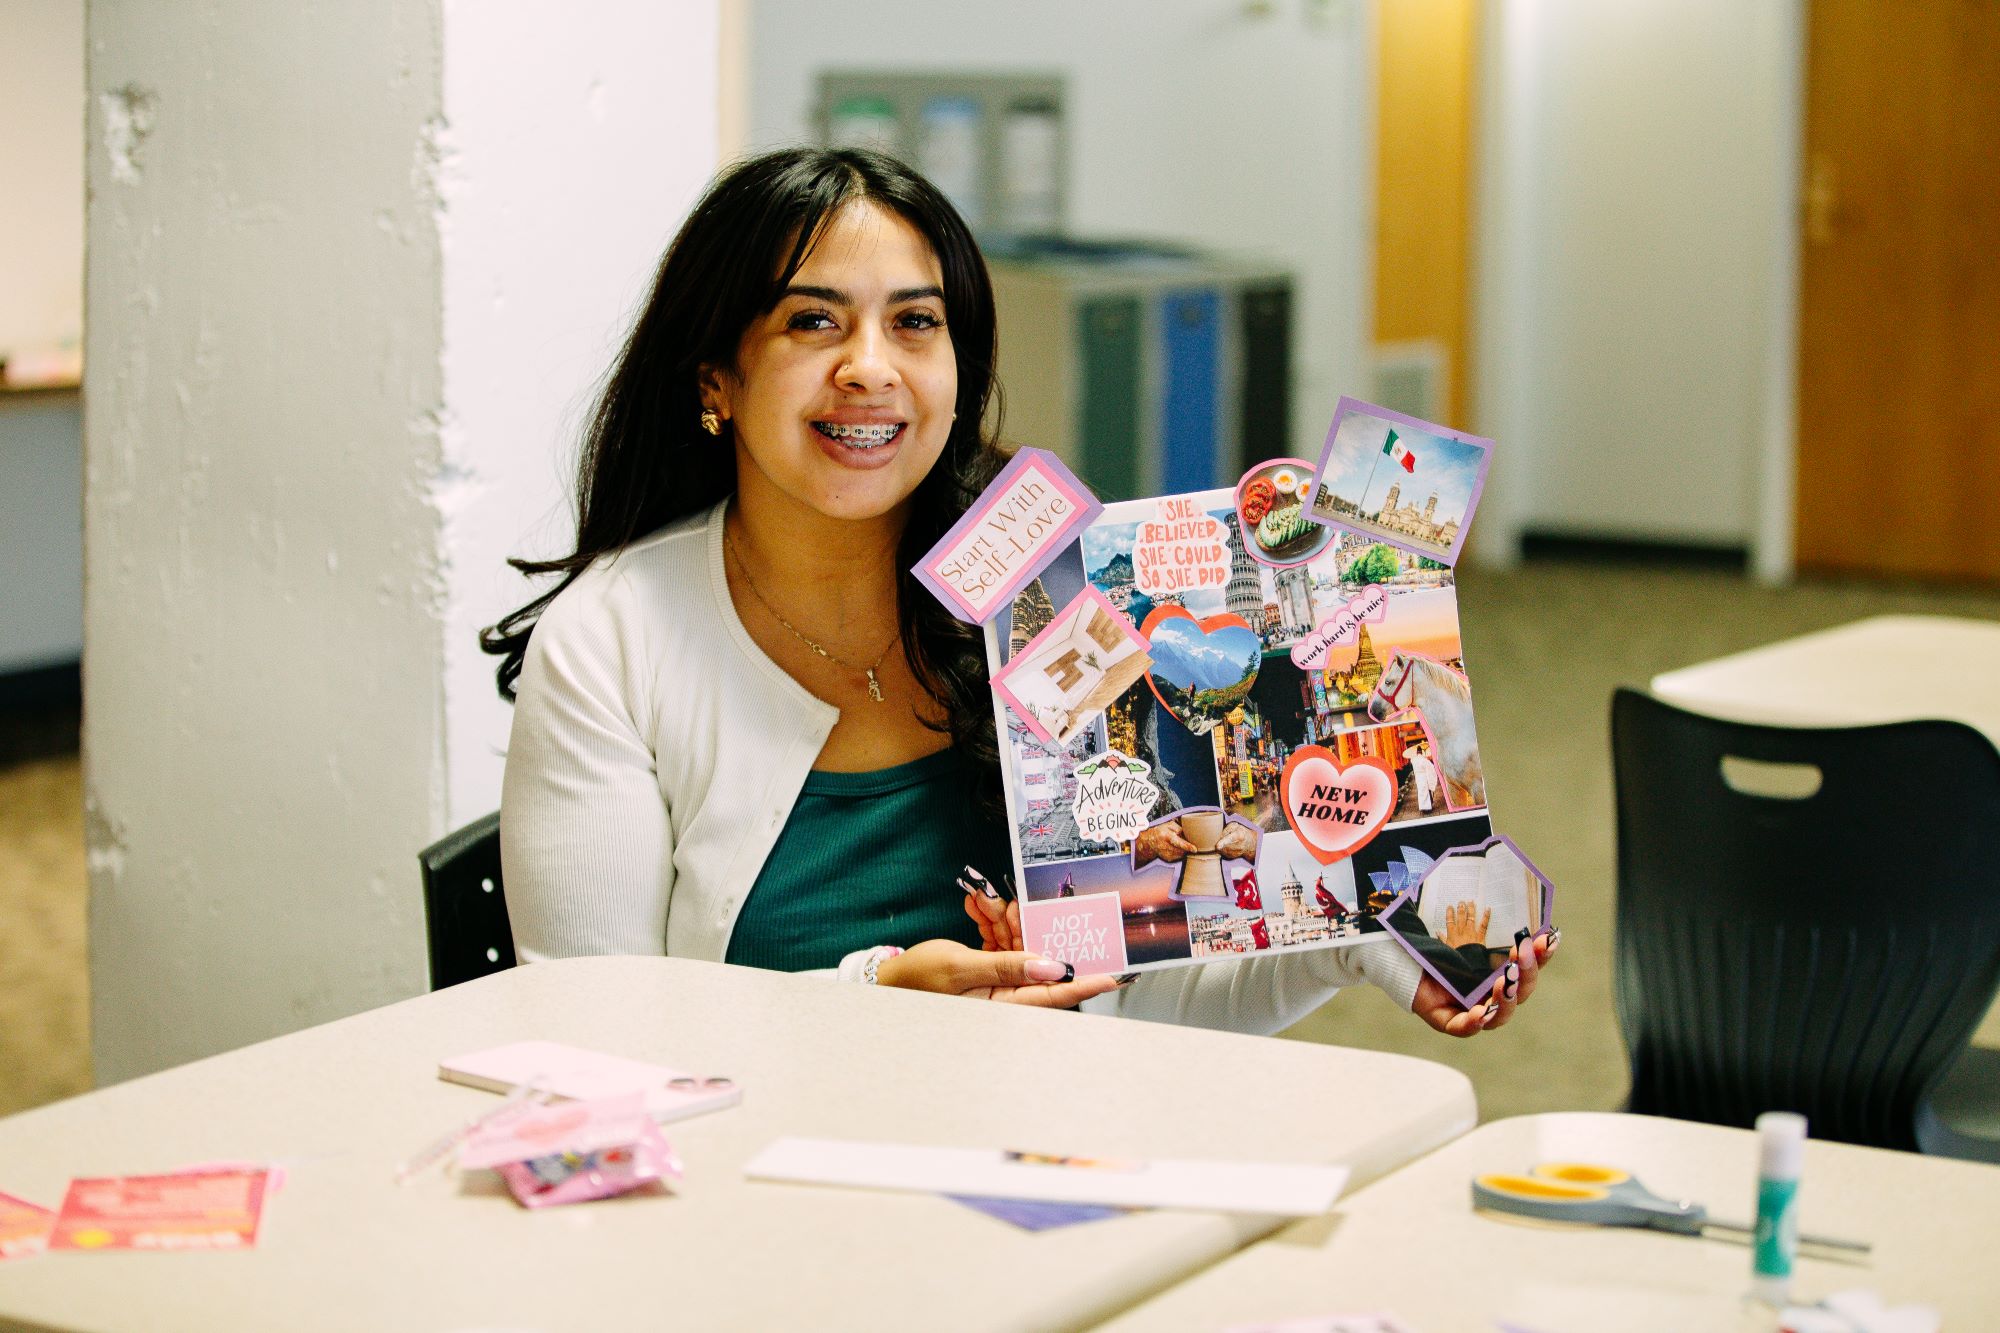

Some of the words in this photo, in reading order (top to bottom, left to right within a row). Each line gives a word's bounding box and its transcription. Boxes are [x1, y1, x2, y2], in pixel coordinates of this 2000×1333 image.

[1166, 499, 1194, 521] SHE
[941, 535, 993, 584] Start
[988, 483, 1045, 532] With
[1145, 520, 1217, 544] BELIEVED
[962, 498, 1067, 601] Self-Love
[1139, 546, 1167, 569] SHE
[1141, 568, 1160, 590] SO
[1166, 568, 1194, 590] SHE
[1199, 566, 1226, 586] DID
[1300, 645, 1324, 666] work
[1322, 625, 1347, 647] hard
[1345, 619, 1357, 629] &
[1353, 610, 1366, 622] be
[1366, 595, 1385, 613] nice
[1310, 784, 1367, 805] NEW
[1297, 802, 1369, 826] HOME
[1052, 913, 1093, 933] NOT
[1042, 927, 1108, 950] TODAY
